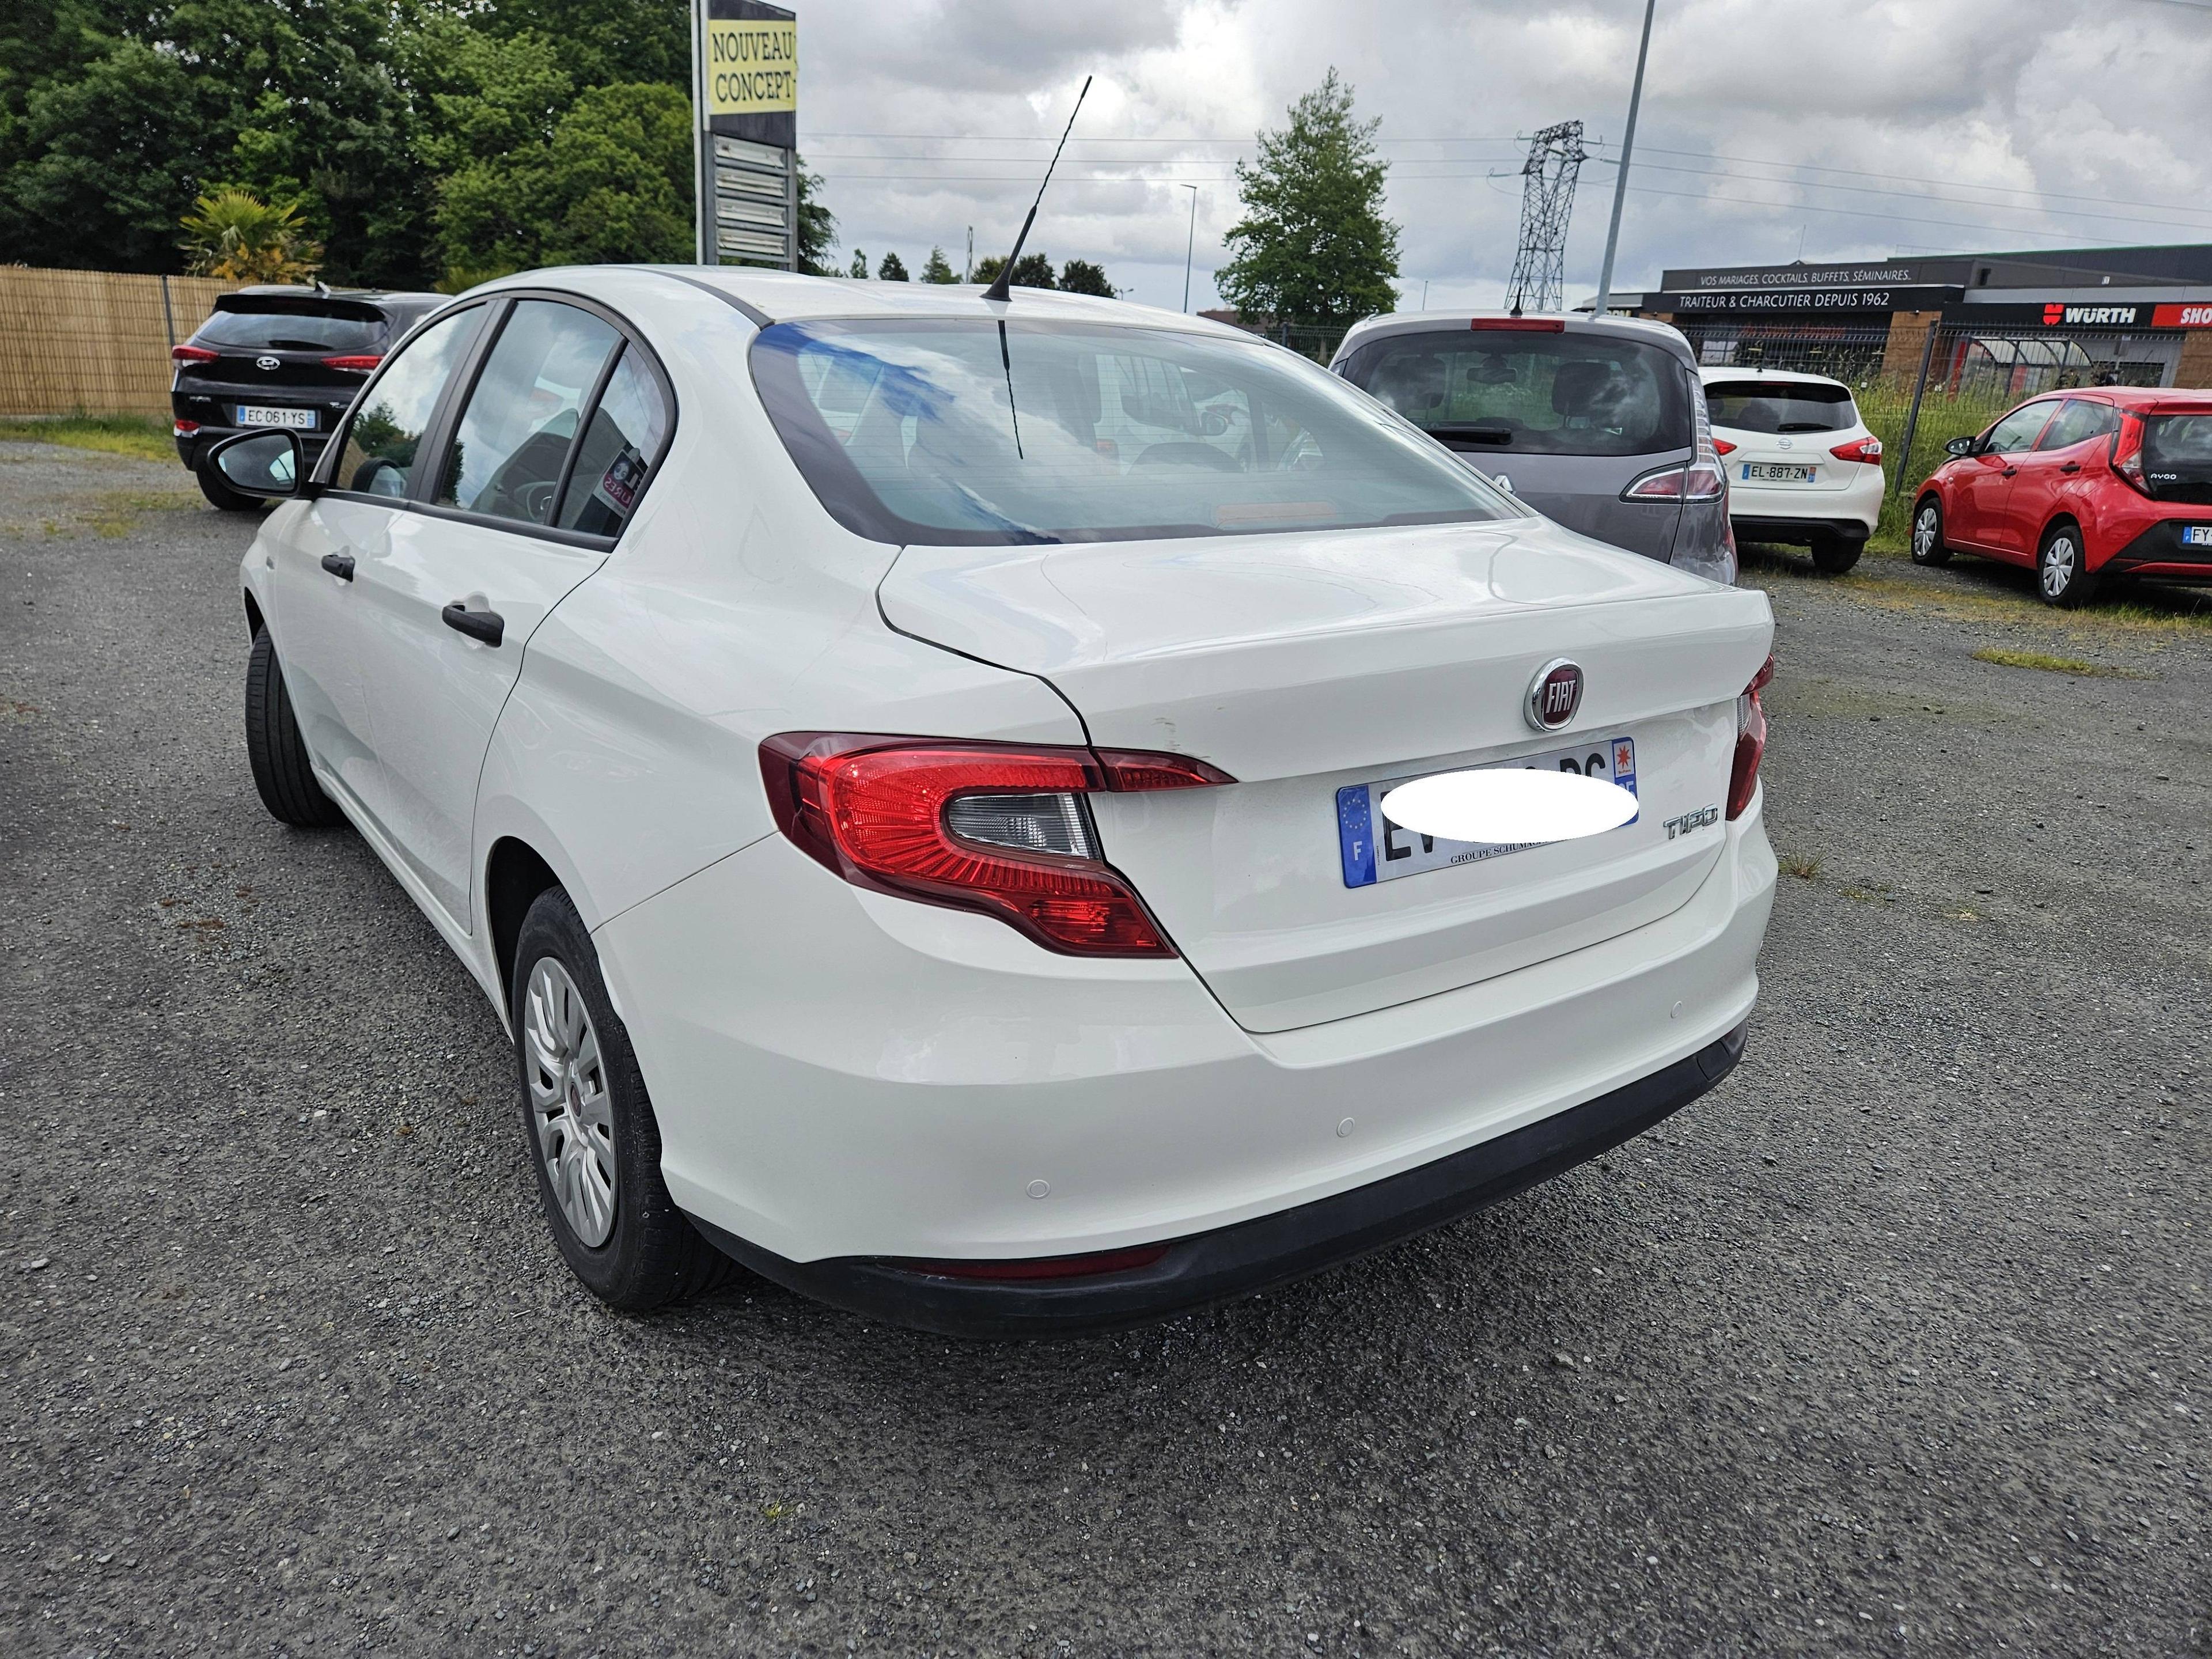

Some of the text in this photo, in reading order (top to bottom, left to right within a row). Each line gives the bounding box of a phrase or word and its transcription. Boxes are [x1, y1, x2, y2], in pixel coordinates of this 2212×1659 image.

[712, 32, 792, 63] NOUVEAU
[715, 70, 791, 103] CONCEPT
[1700, 276, 1717, 286] VOS
[1679, 291, 1890, 308] TRAITEUR & CHARCUTIER DEPUIS 1962
[2065, 307, 2136, 324] WÜRTH
[1751, 466, 1808, 479] EL-887-ZN
[1546, 680, 1576, 714] FIAT
[1663, 804, 1718, 840] TIPO
[1354, 841, 1362, 861] F
[1450, 849, 1492, 864] GROUPE
